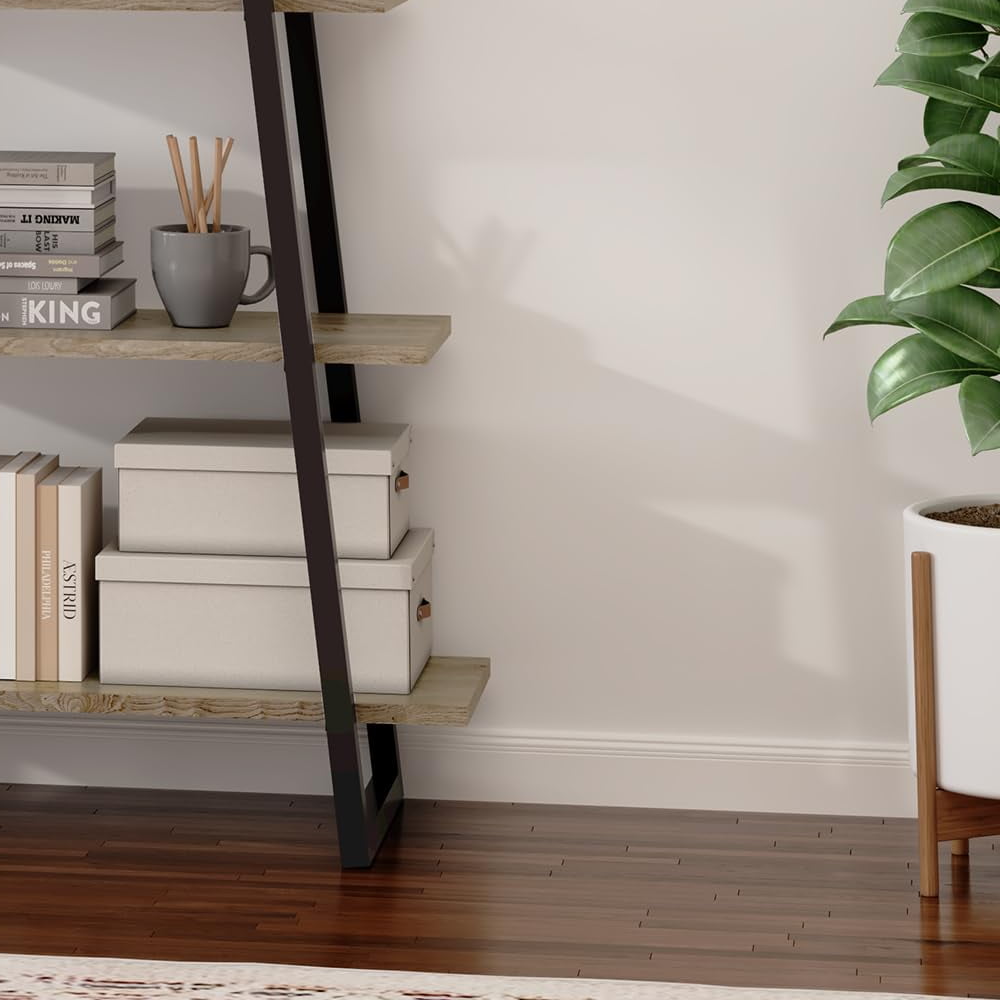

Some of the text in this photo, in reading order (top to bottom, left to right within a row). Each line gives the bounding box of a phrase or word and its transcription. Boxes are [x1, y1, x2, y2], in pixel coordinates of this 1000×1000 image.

[20, 214, 32, 224] IT
[34, 214, 80, 225] MAKING
[6, 261, 12, 269] of
[14, 261, 37, 270] Spaces
[28, 300, 101, 325] KING
[40, 550, 52, 620] PHILADELPHIA
[62, 559, 77, 620] ASTRID
